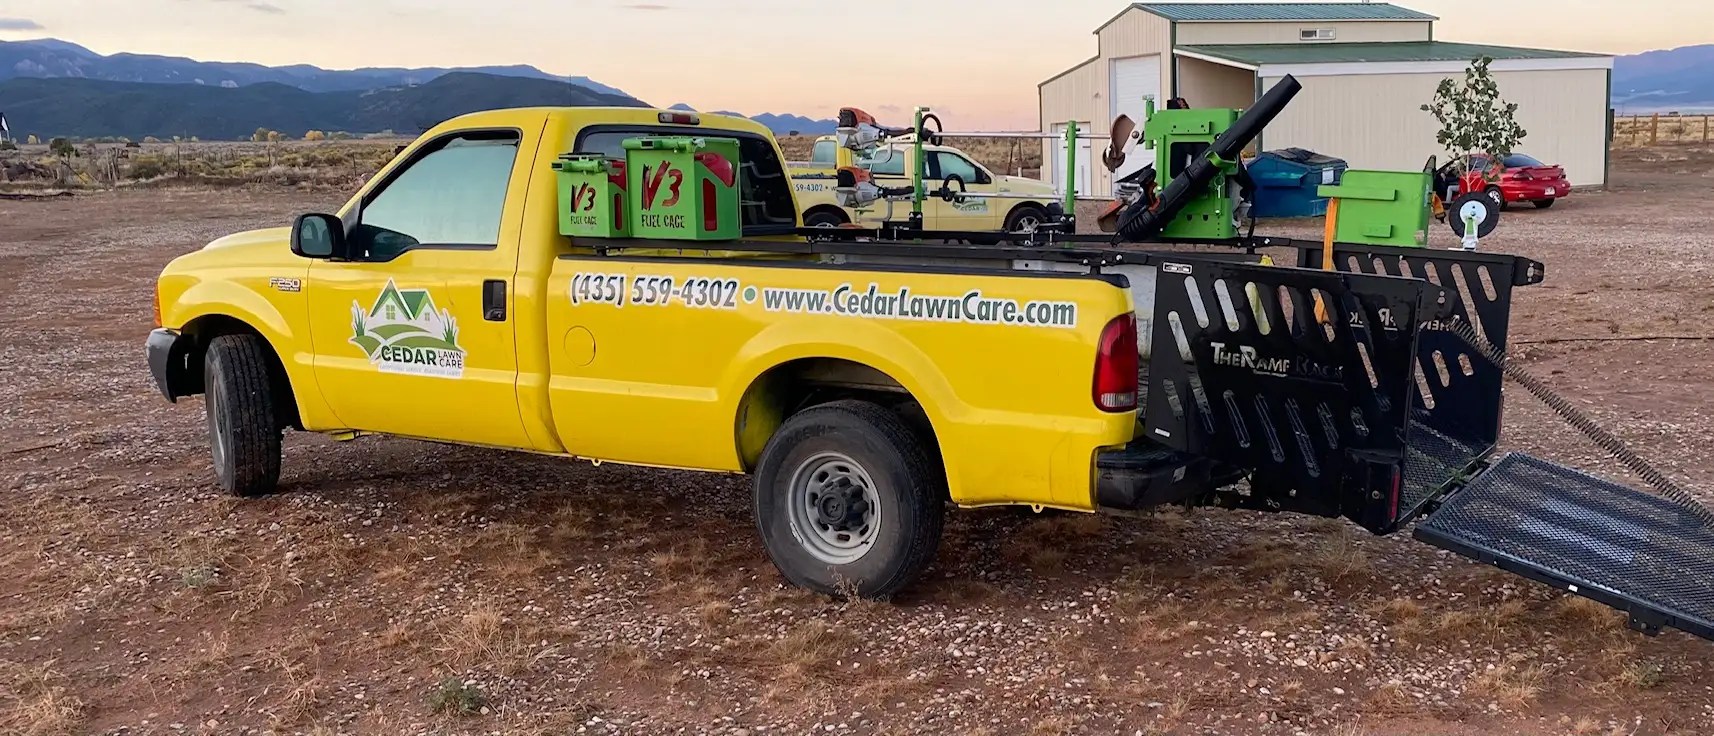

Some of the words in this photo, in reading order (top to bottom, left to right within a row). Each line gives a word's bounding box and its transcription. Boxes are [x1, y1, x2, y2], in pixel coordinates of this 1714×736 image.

[641, 160, 683, 211] V3
[794, 183, 823, 192] 59-4302
[570, 181, 596, 213] V3
[570, 216, 583, 225] FUEL
[584, 216, 597, 225] CAGE
[641, 214, 661, 228] FUEL
[663, 215, 685, 229] CAGE
[571, 274, 624, 305] (435)
[632, 276, 737, 307] 559-4302
[764, 285, 1074, 325] www.CedarLawnCare.com
[381, 345, 437, 366] CEDAR
[438, 350, 462, 359] LAWN
[439, 358, 462, 369] CARE
